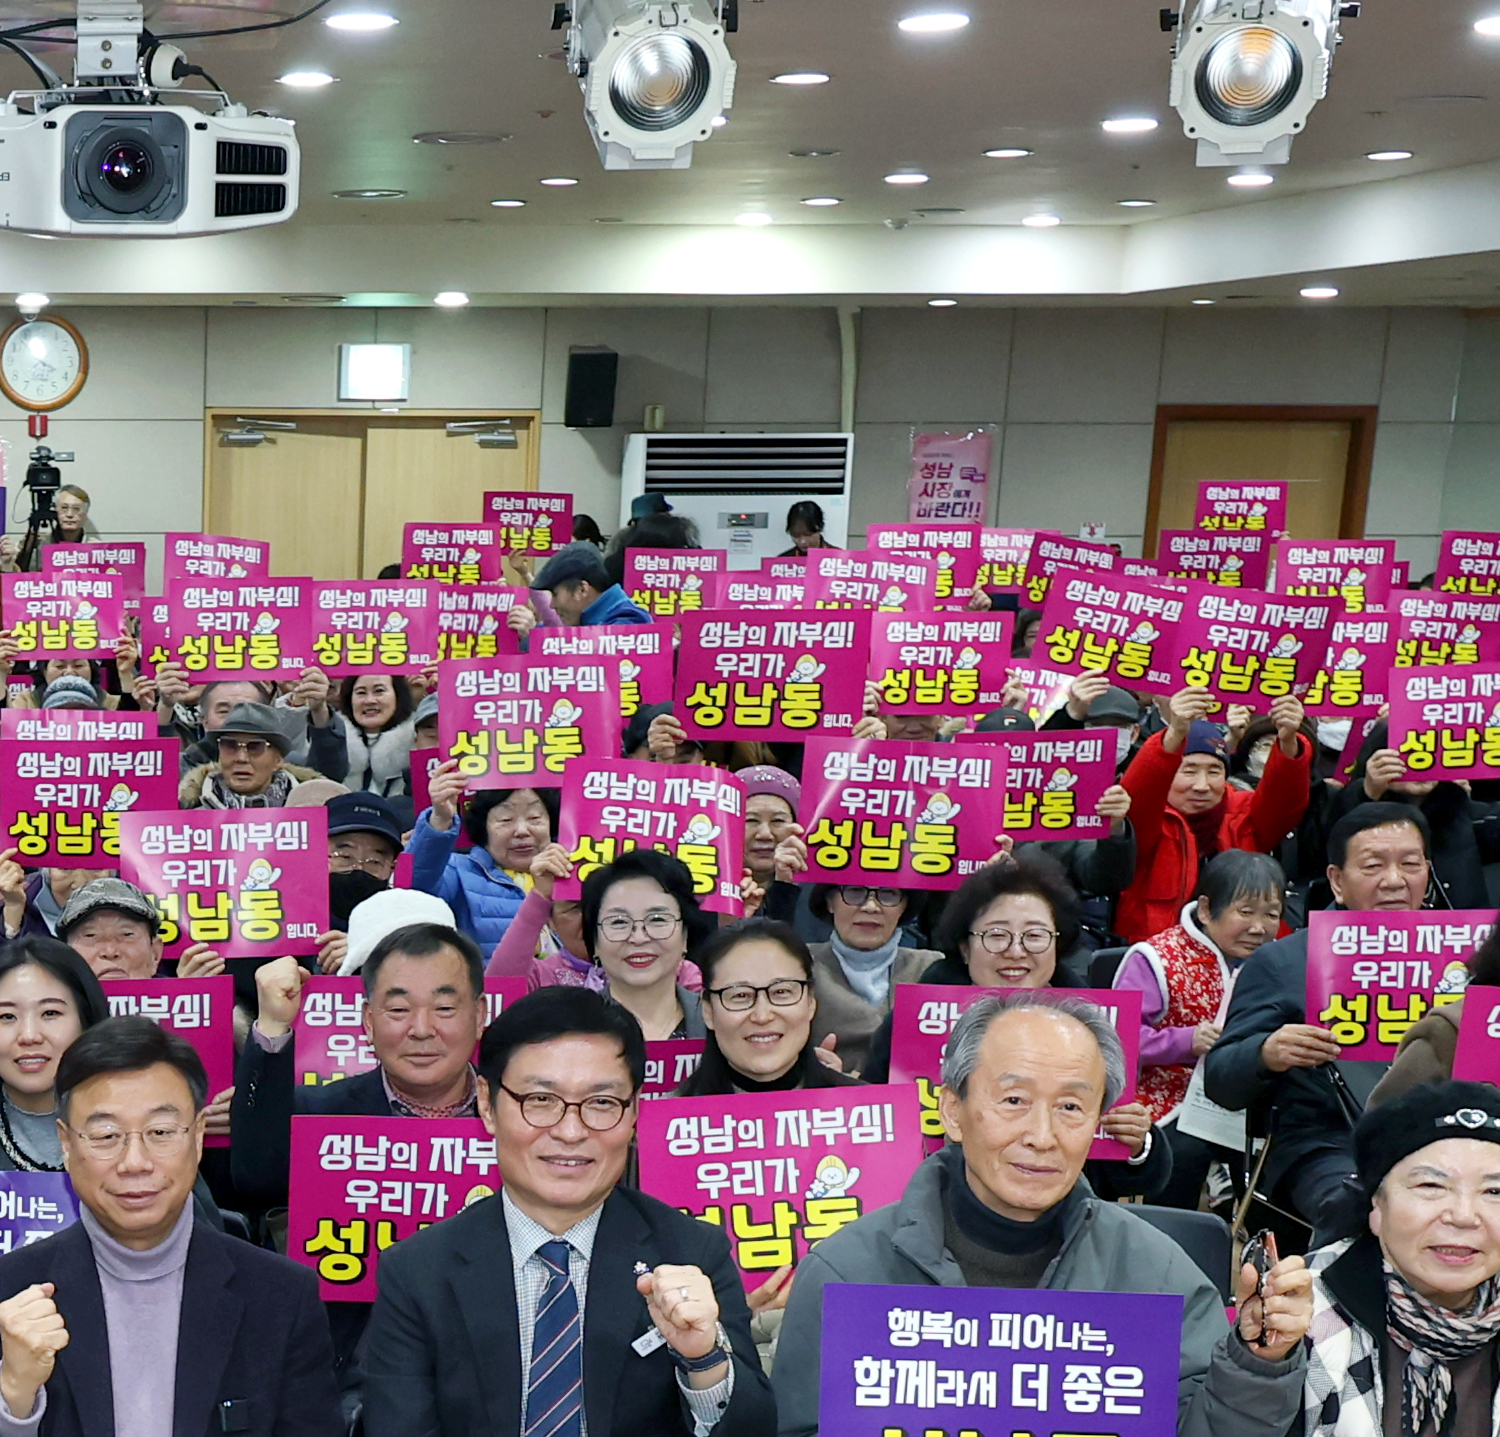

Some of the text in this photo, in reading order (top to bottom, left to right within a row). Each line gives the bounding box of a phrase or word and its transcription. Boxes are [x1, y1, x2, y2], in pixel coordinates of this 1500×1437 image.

[24, 381, 29, 390] 7
[62, 372, 68, 381] 4
[37, 385, 43, 396] 6
[920, 462, 954, 479] 성남
[917, 502, 981, 517] 바란다!!
[183, 587, 299, 608] 성남의 자부심!
[197, 612, 250, 631] 우리가
[700, 622, 854, 647] 성남의 자부심!
[178, 634, 281, 671] 성남동
[715, 654, 785, 678] 우리가
[1406, 676, 1466, 700] 성남의
[685, 681, 853, 729] 성남동 입니다.
[137, 821, 308, 854] 성남의 자부심!
[157, 855, 240, 891] 우리가
[666, 1104, 894, 1155] 성남의 자부심!
[888, 1308, 1114, 1356] 행복이 피어나는,
[854, 1356, 1143, 1414] 함께라서 더 좋은
